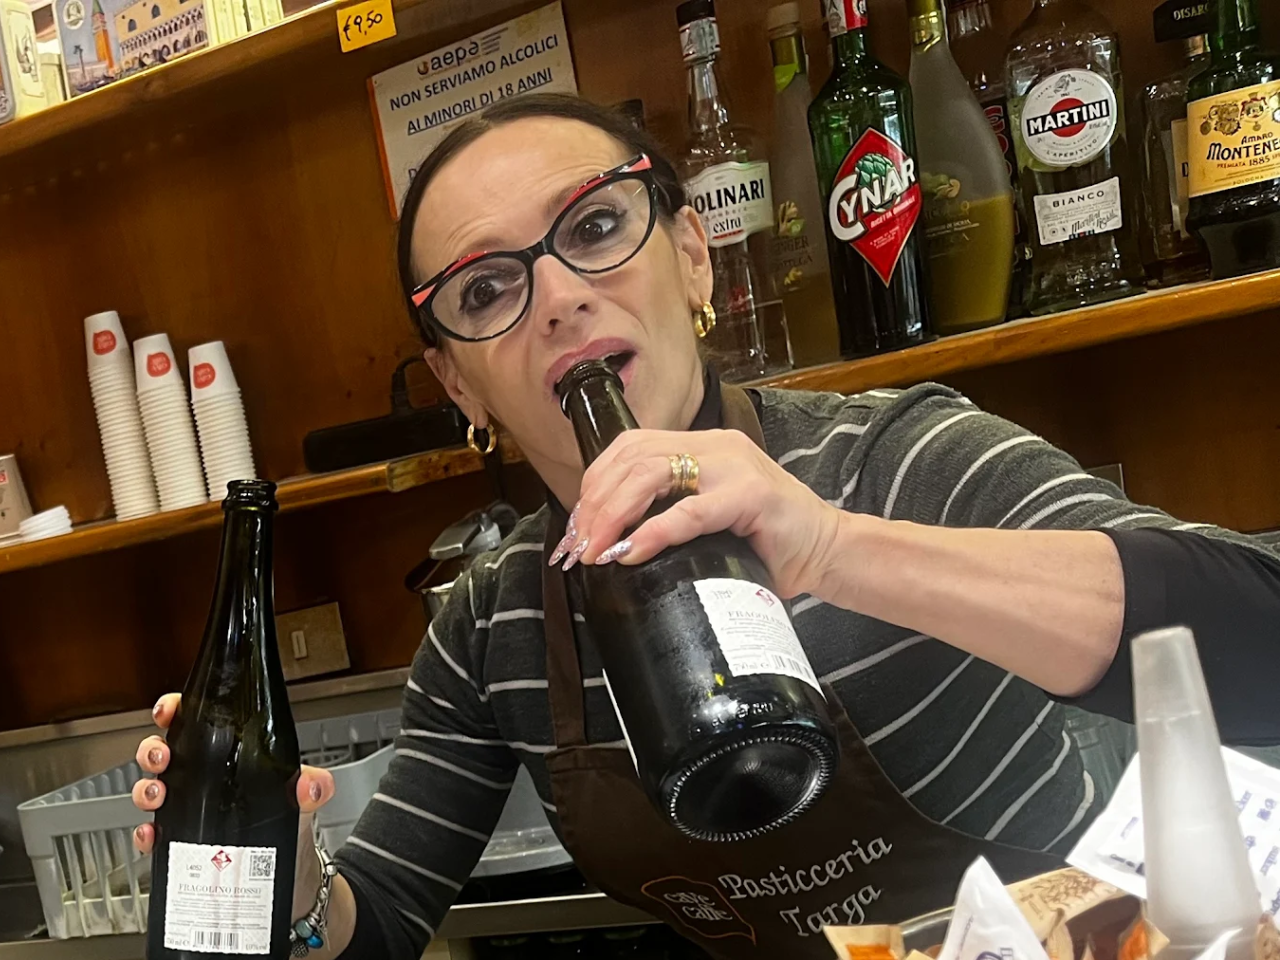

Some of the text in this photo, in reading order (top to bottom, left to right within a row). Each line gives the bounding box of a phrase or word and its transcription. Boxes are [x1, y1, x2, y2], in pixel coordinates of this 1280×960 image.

[342, 9, 383, 42] €9,50
[389, 34, 559, 111] NON SERVIAMO ALCOLICI
[407, 67, 553, 137] AI MINORI DI 18 ANNI
[1029, 101, 1108, 135] MARTINI
[1248, 155, 1271, 167] 1885
[690, 178, 766, 215] OLINARI
[829, 157, 916, 241] CYNAR
[1052, 190, 1105, 208] BIANCO
[713, 217, 742, 234] extra
[717, 836, 893, 900] Pasticceria
[779, 884, 884, 938] Targa
